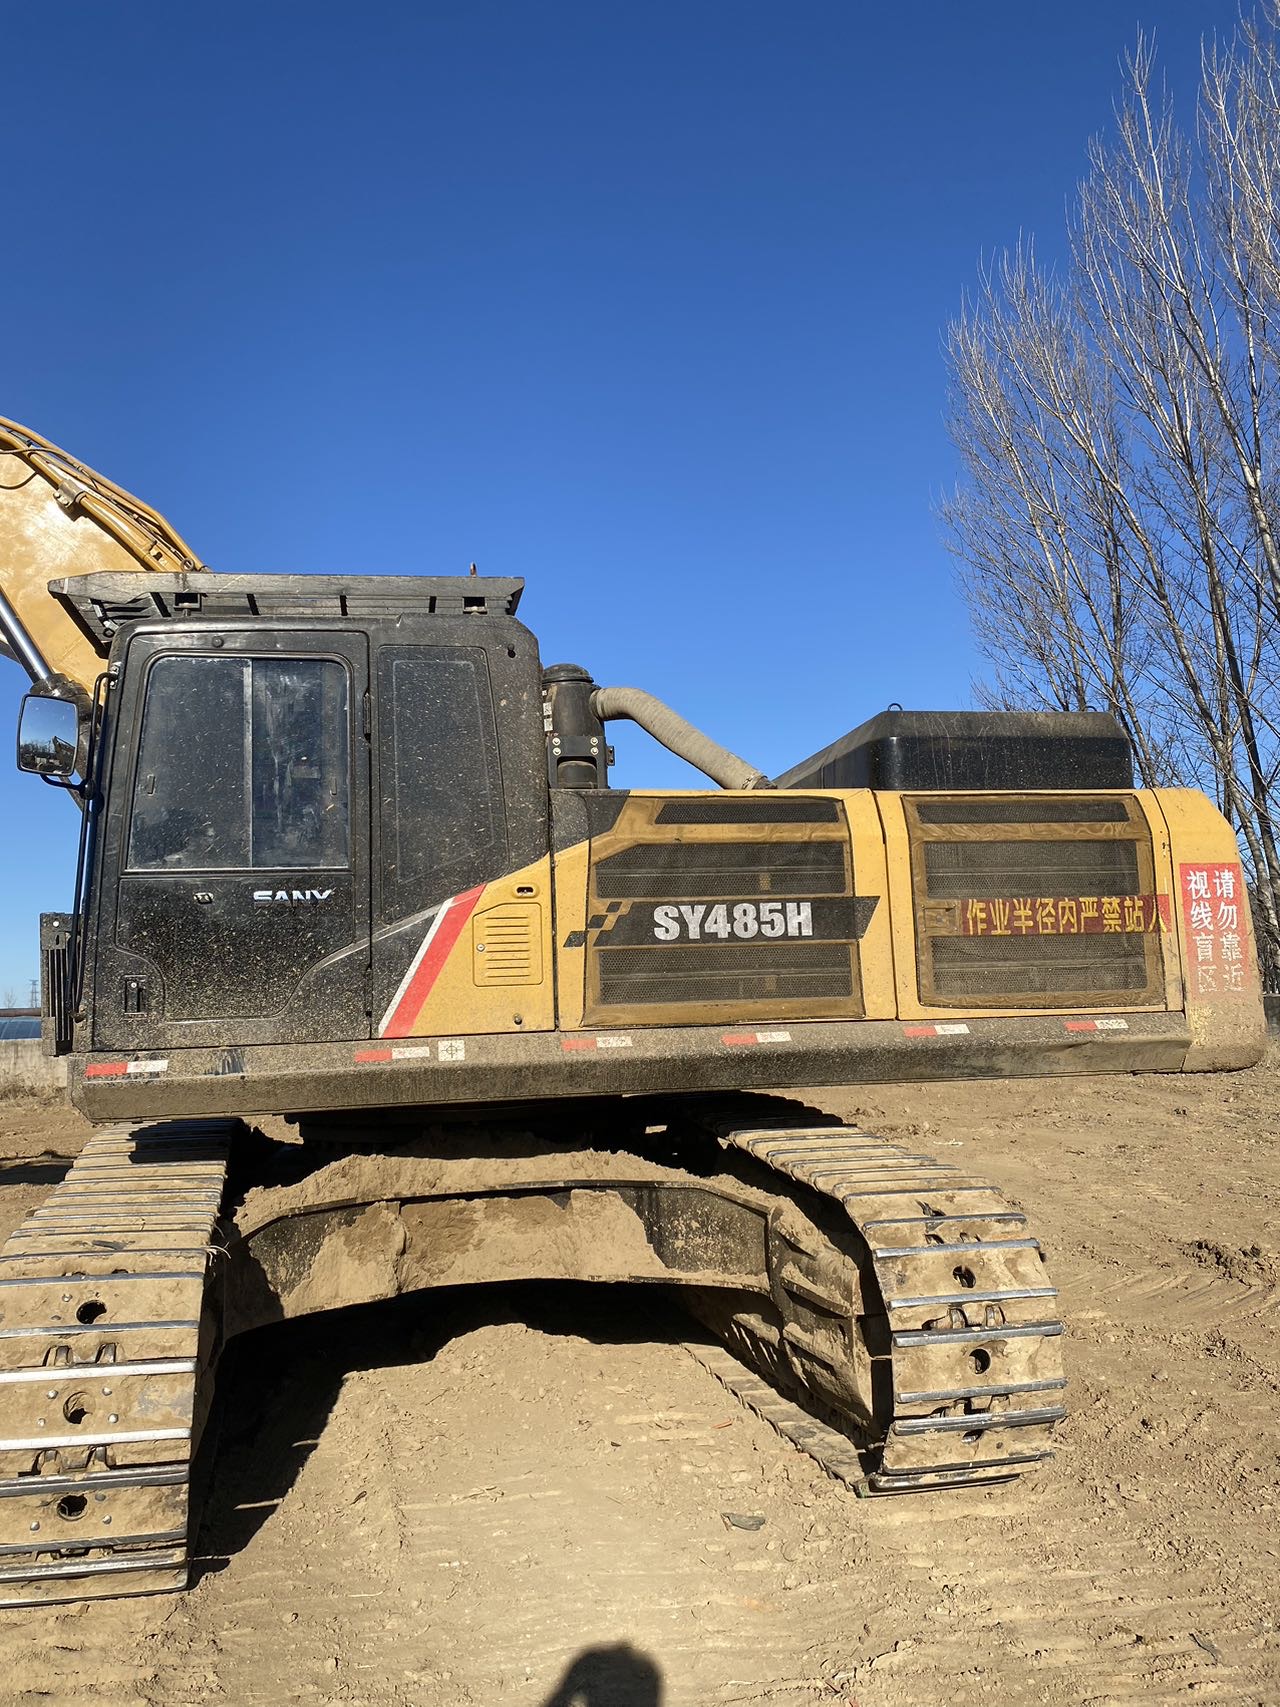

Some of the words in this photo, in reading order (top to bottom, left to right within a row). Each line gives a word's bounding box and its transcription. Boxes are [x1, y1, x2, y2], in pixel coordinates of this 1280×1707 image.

[253, 889, 333, 903] SANY
[653, 902, 813, 941] SY485H
[967, 896, 1167, 936] 作业半径内严禁站人
